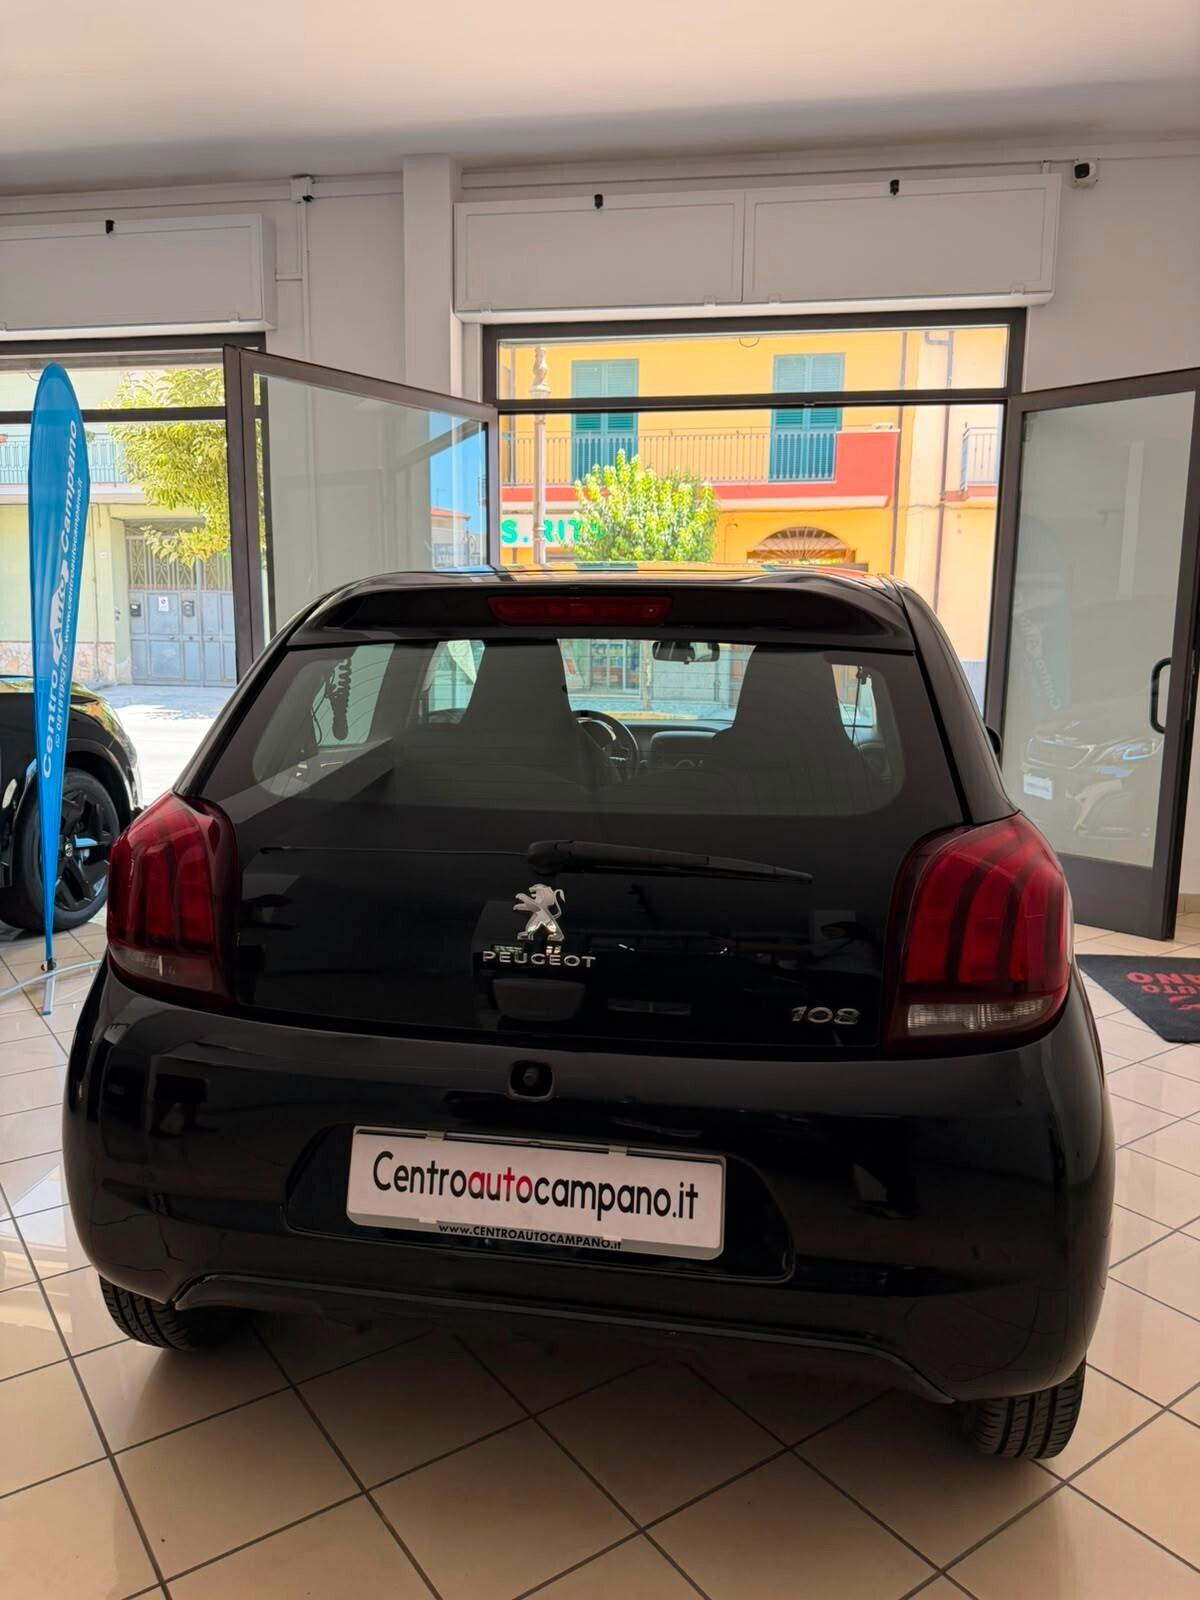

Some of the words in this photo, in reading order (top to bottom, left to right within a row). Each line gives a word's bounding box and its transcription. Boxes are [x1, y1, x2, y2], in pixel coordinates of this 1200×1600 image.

[500, 518, 529, 544] S.
[43, 671, 58, 779] Centro
[53, 574, 66, 651] Auto
[60, 419, 78, 553] Campano
[482, 951, 597, 968] PEUGEOT
[791, 1006, 861, 1025] 108
[373, 1150, 699, 1222] Centroautocampano.it
